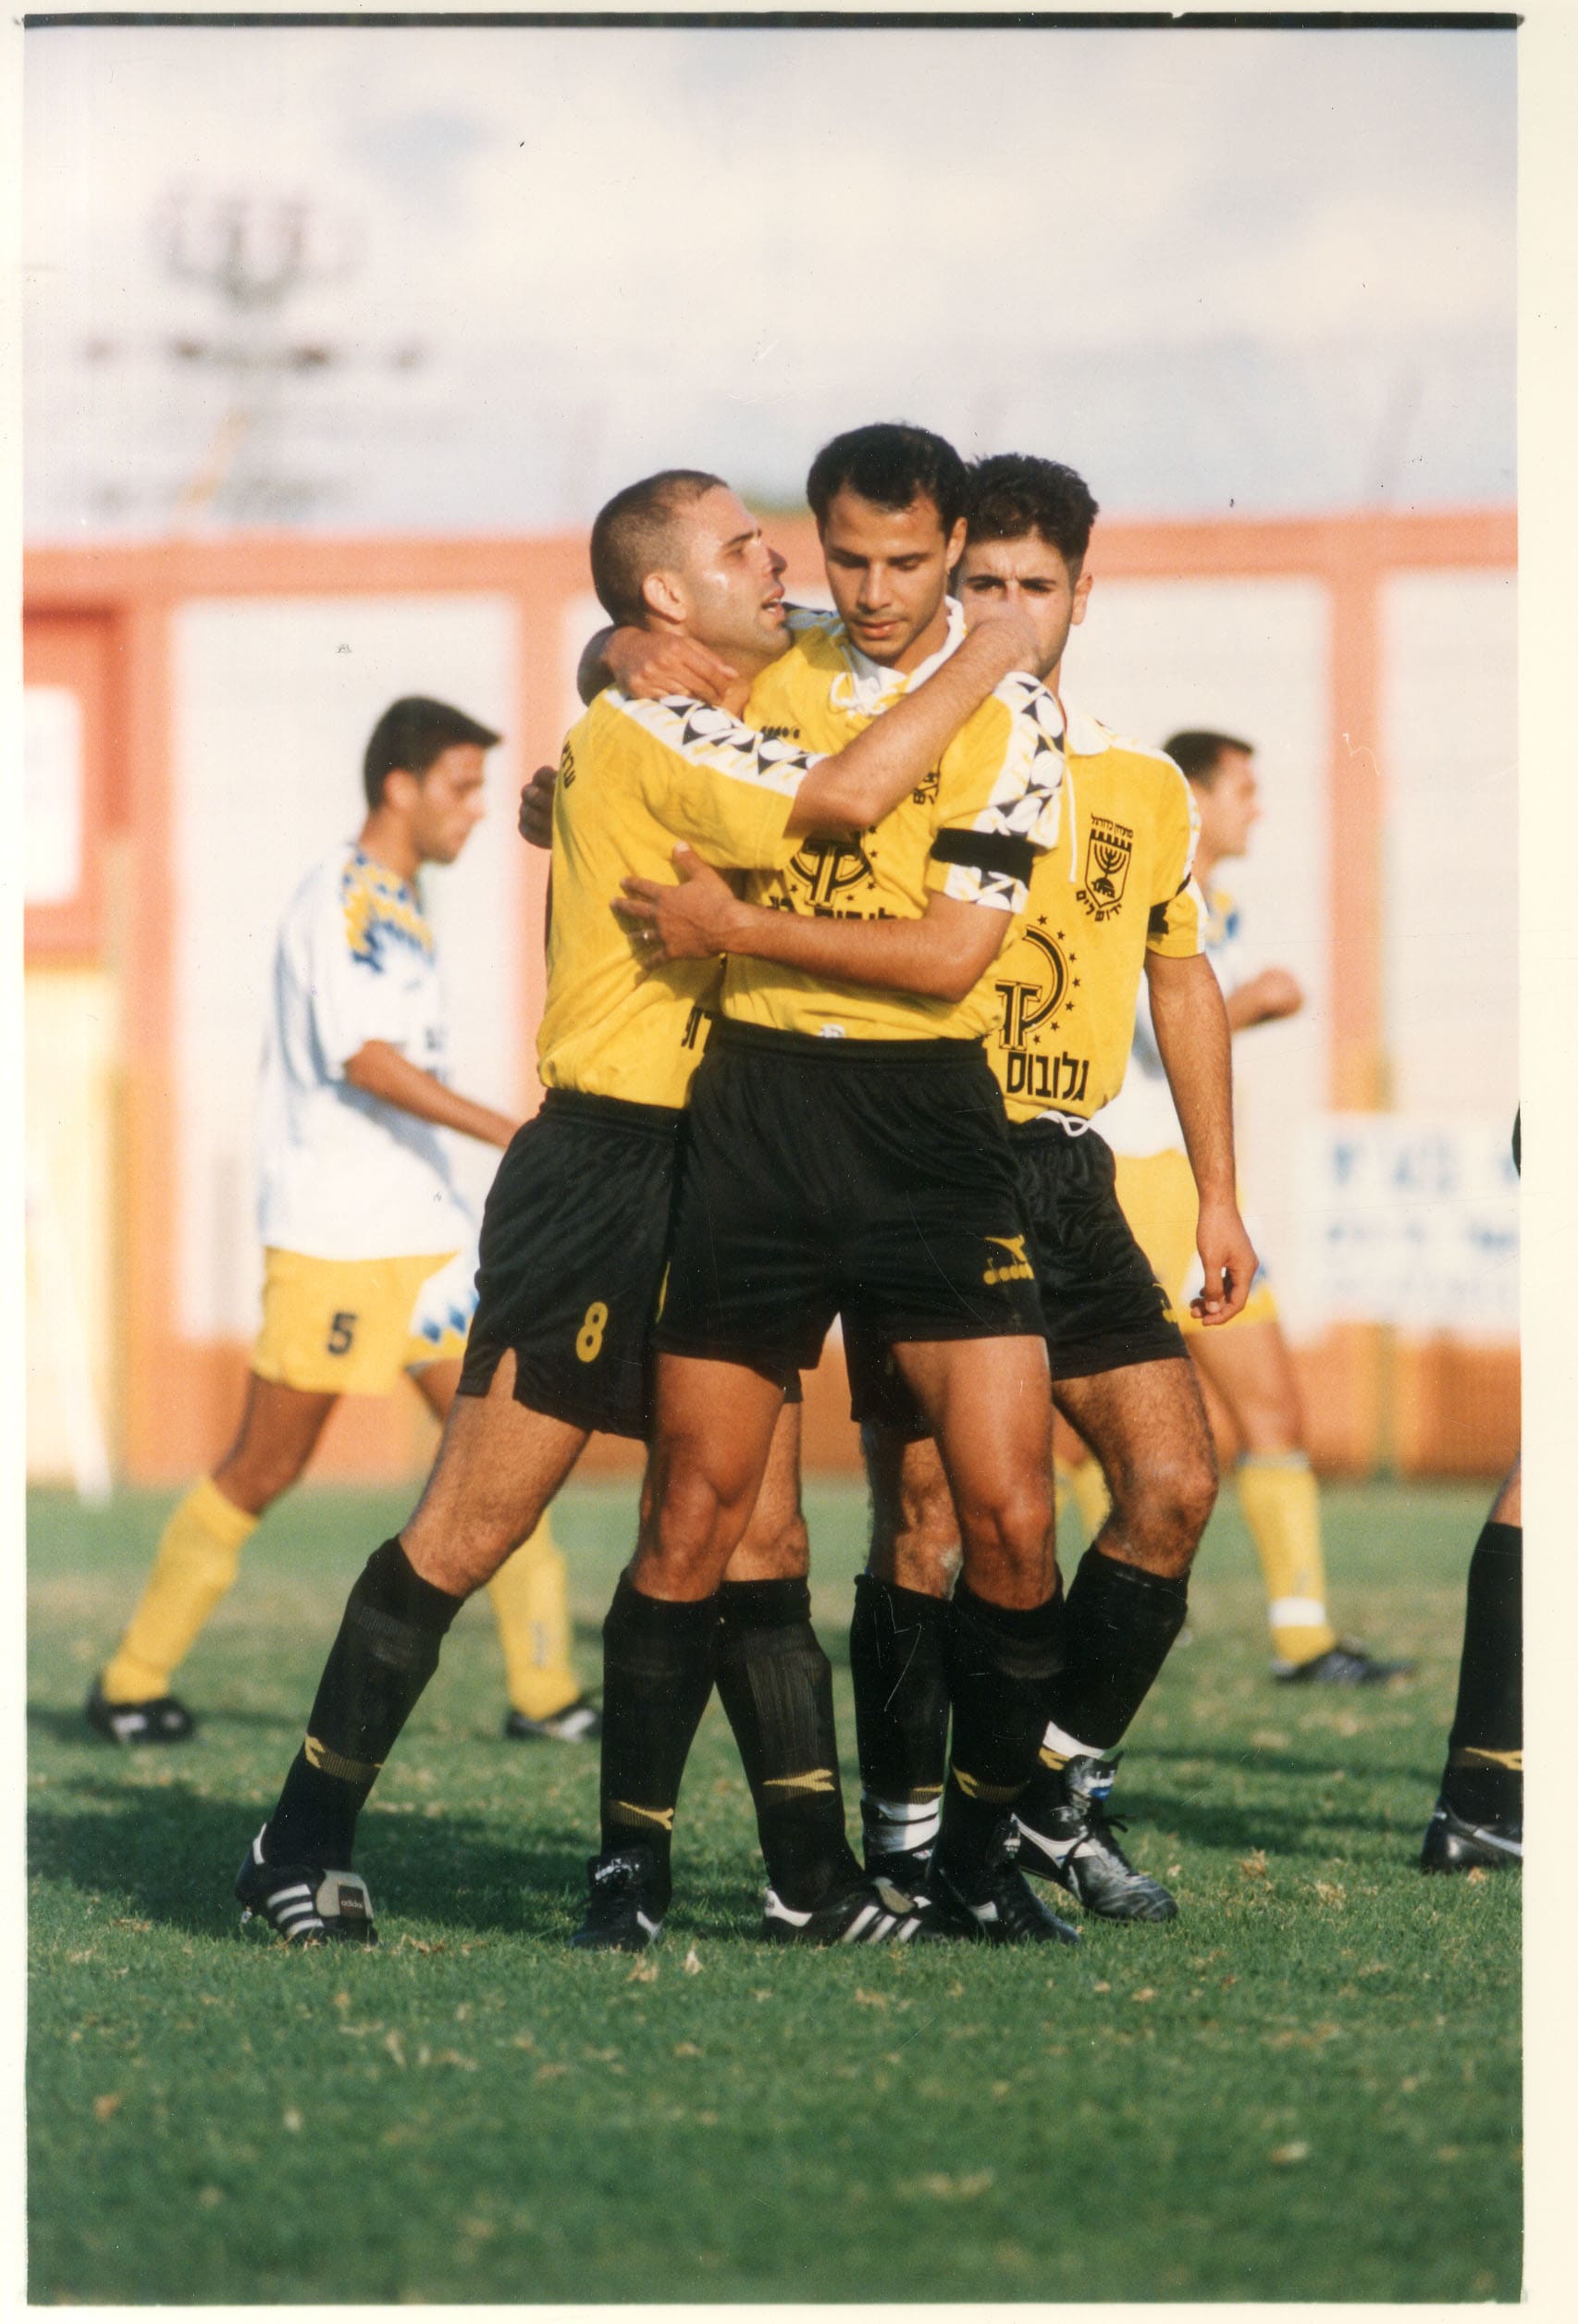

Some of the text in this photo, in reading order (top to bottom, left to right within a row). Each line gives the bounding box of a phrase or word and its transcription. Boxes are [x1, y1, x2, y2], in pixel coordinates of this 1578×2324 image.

[1006, 1051, 1089, 1101] גלובוס
[327, 1312, 356, 1355] 5
[576, 1301, 608, 1363] 8
